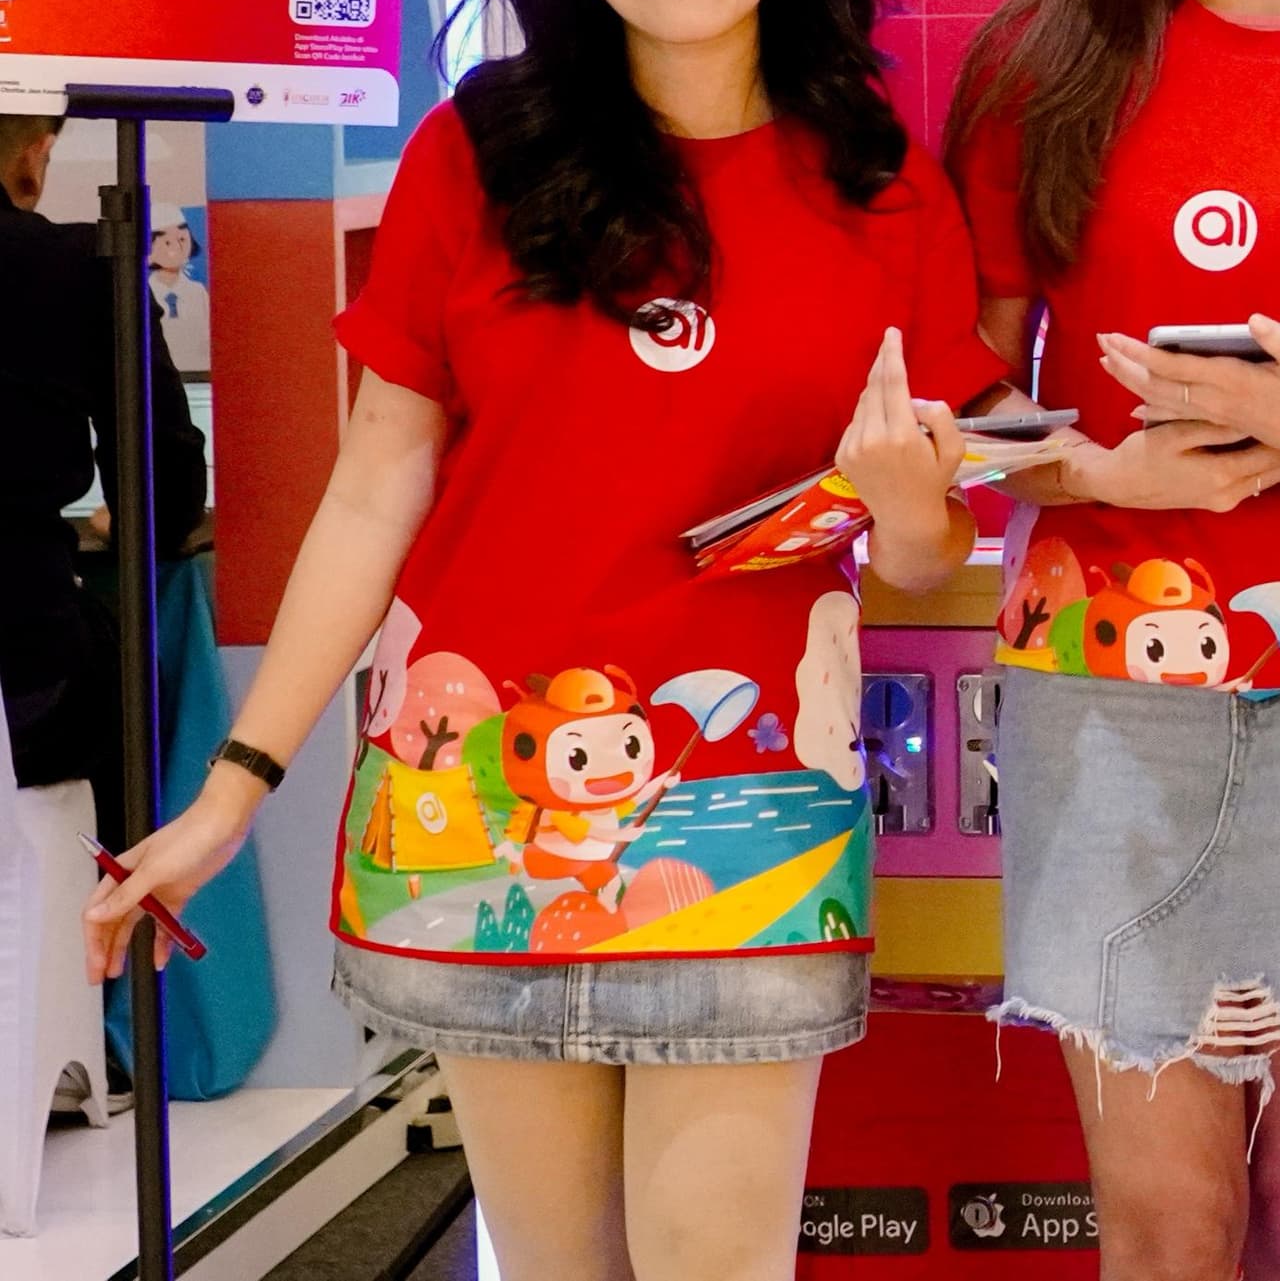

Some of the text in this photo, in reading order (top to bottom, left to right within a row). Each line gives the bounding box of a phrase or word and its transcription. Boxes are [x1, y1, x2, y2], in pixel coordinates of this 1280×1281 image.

[1022, 1191, 1095, 1208] Downloa
[861, 1213, 918, 1244] Play
[1022, 1213, 1079, 1244] App
